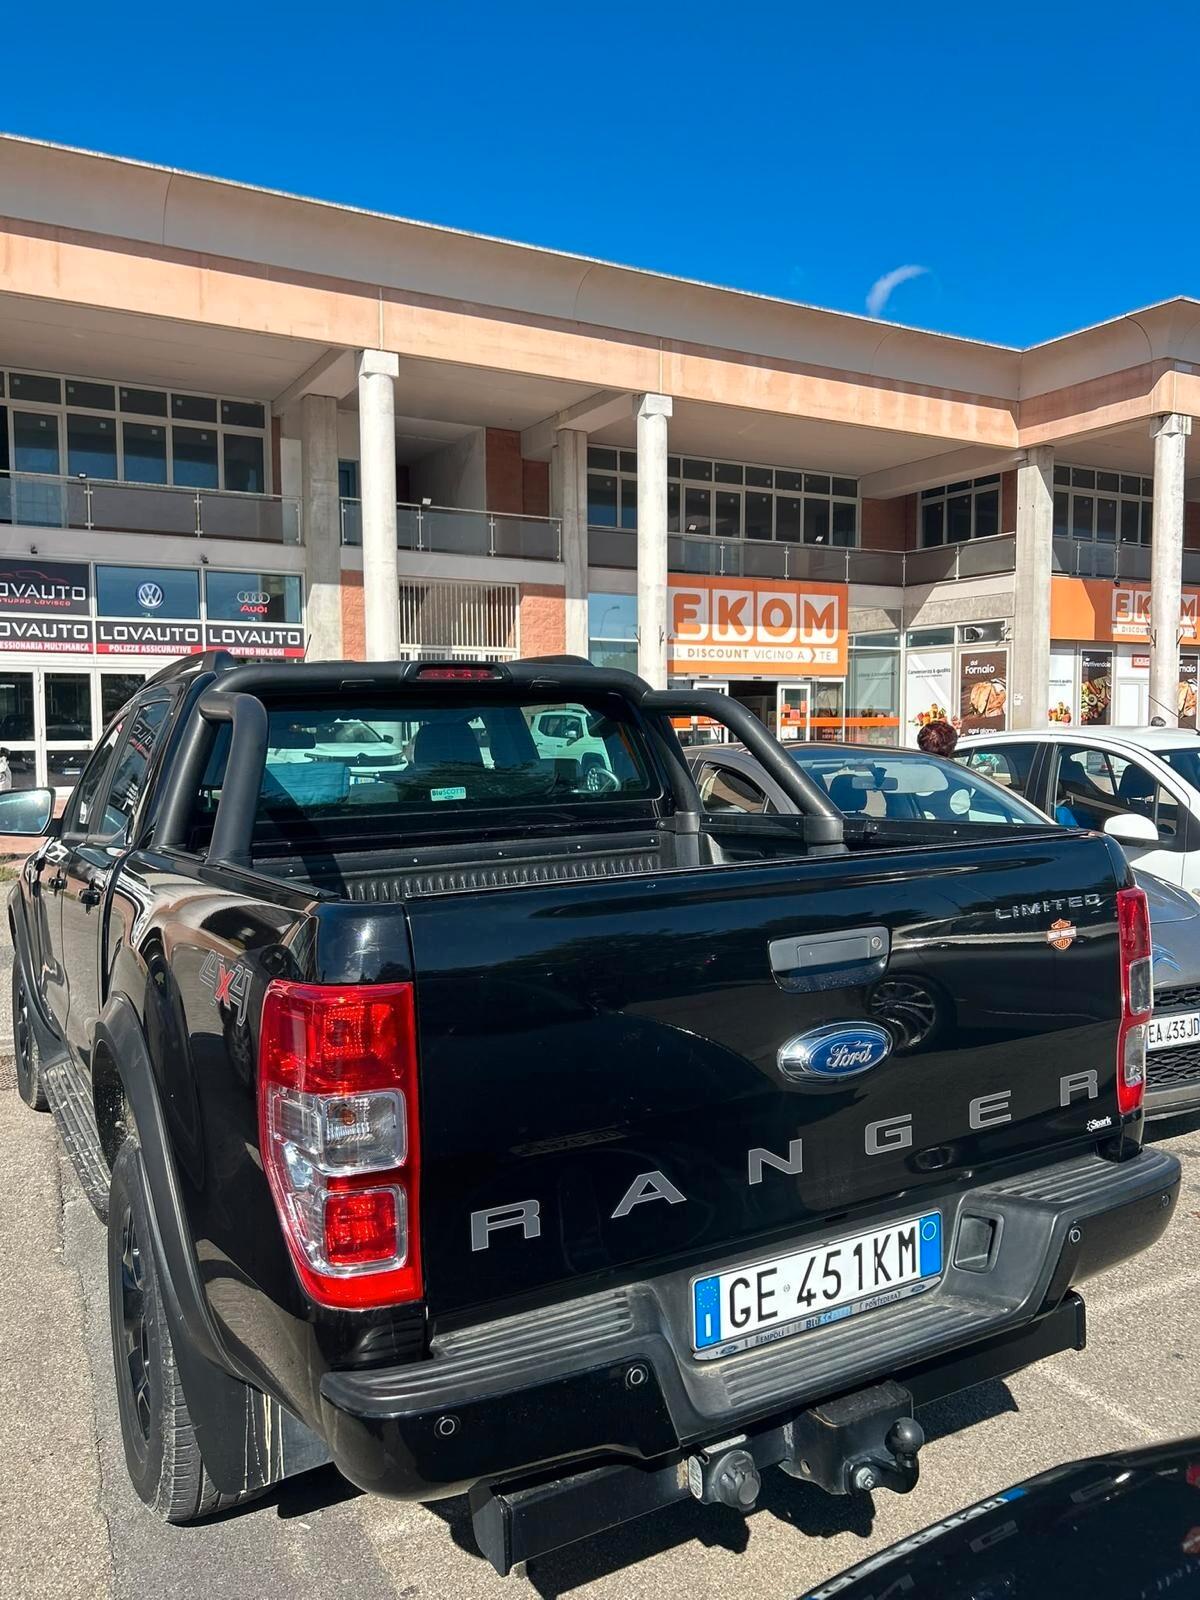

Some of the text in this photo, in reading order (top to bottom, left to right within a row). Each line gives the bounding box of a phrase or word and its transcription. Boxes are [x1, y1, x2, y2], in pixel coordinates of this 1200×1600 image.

[34, 599, 71, 607] LOVISCO
[1116, 592, 1196, 620] EKM
[672, 592, 836, 640] EKOM
[100, 625, 198, 642] LOVAUTO
[209, 628, 300, 645] LOVAUTO
[44, 642, 89, 651] MULTIMARCA
[109, 644, 191, 654] POLIZZE ASSICURATIVE
[255, 647, 285, 656] NOLEGGI
[687, 647, 748, 659] DISCOUNT
[752, 649, 793, 660] VICINO
[798, 651, 805, 660] A
[820, 650, 832, 661] TE
[965, 664, 995, 674] Fornaio
[995, 893, 1101, 919] LIMITED
[1149, 1023, 1163, 1043] EA
[826, 1041, 873, 1068] Ford
[1090, 1116, 1112, 1130] Spark
[470, 1069, 1099, 1252] RANGER
[729, 1226, 917, 1329] GE 451KM
